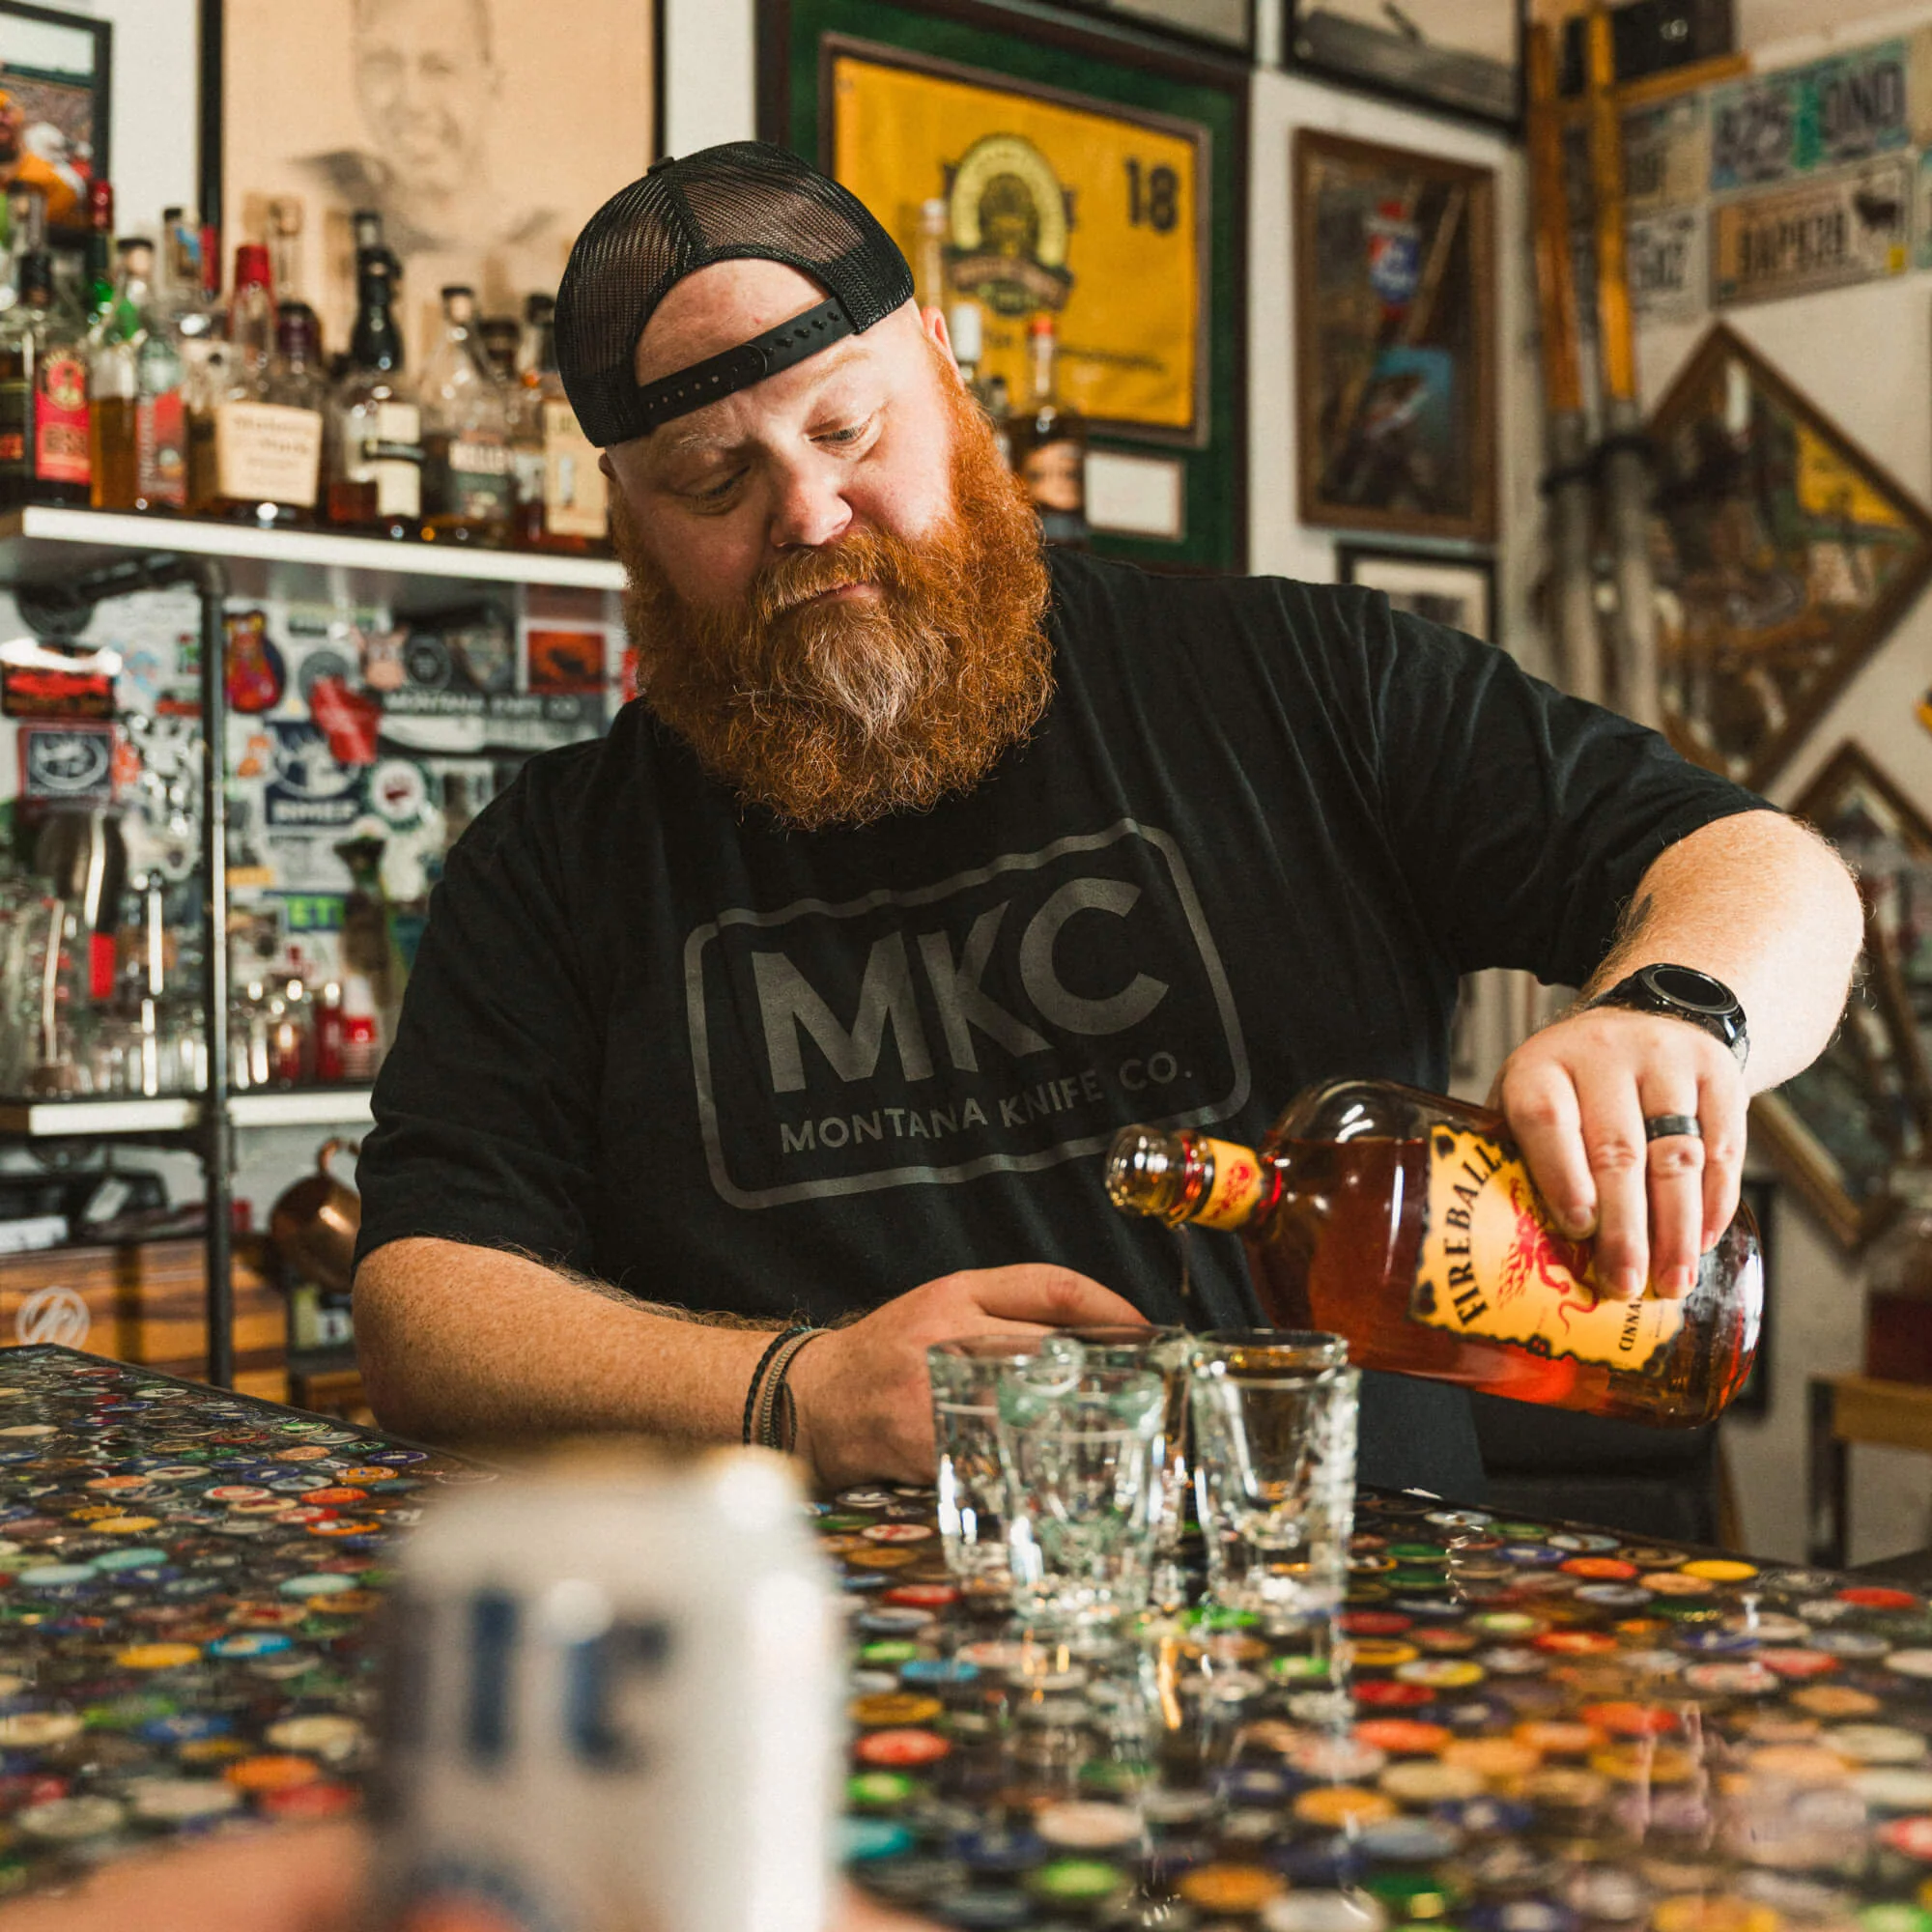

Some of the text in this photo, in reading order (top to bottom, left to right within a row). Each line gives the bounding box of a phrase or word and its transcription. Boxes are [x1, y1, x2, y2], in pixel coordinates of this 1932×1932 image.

[1125, 157, 1179, 235] 18
[751, 877, 1169, 1093] MKC
[780, 1051, 1193, 1153] MONTANA KNIFE CO.
[1444, 1143, 1502, 1327] FIREBALL
[1618, 1295, 1643, 1352] CINNA
